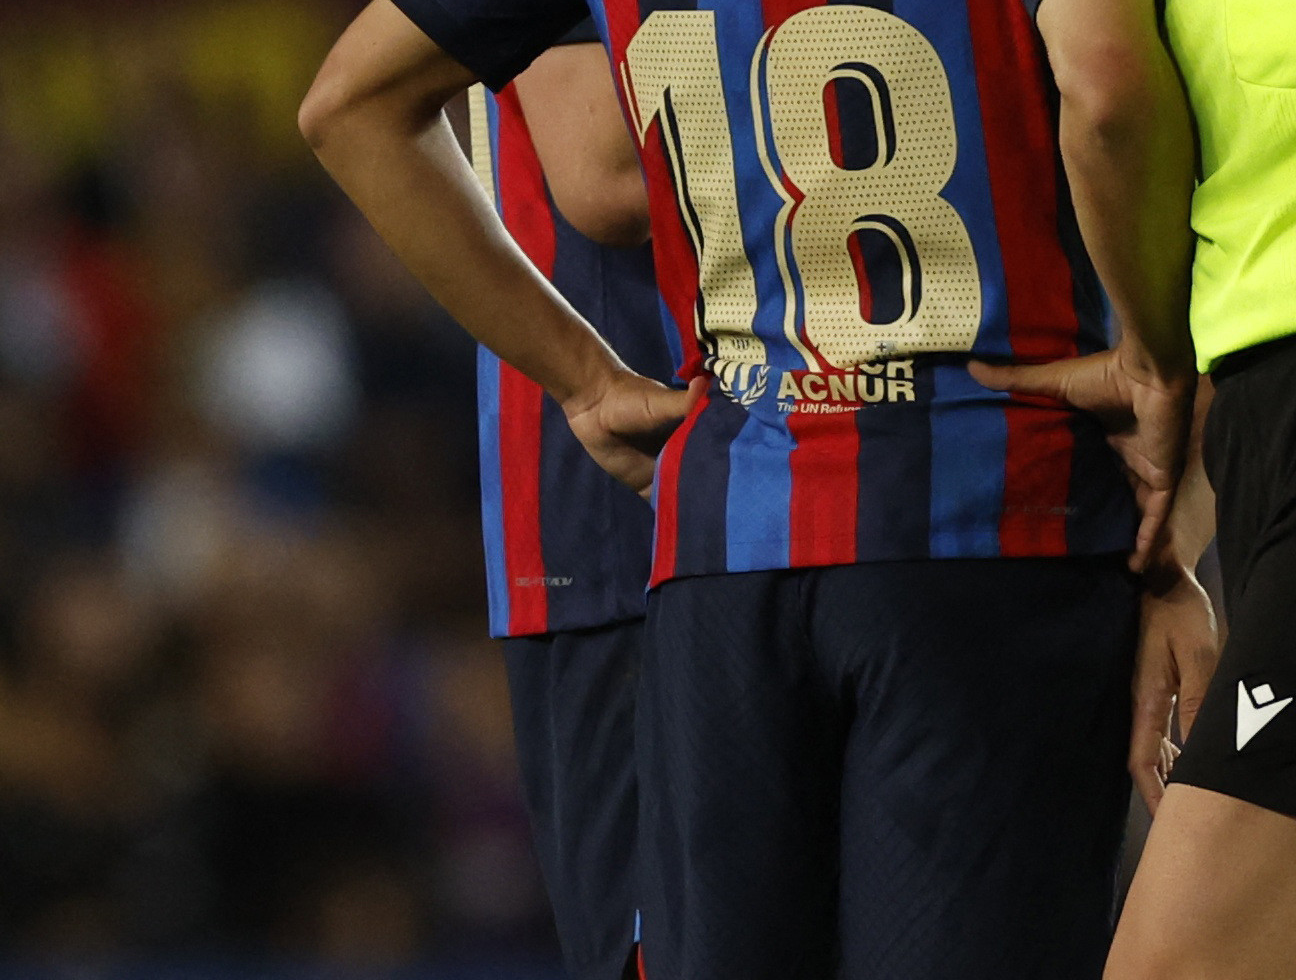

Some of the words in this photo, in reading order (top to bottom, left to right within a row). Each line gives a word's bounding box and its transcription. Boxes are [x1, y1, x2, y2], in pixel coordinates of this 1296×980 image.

[619, 4, 982, 371] 18
[776, 370, 916, 403] ACNUR
[777, 401, 798, 414] The
[800, 403, 819, 415] UN
